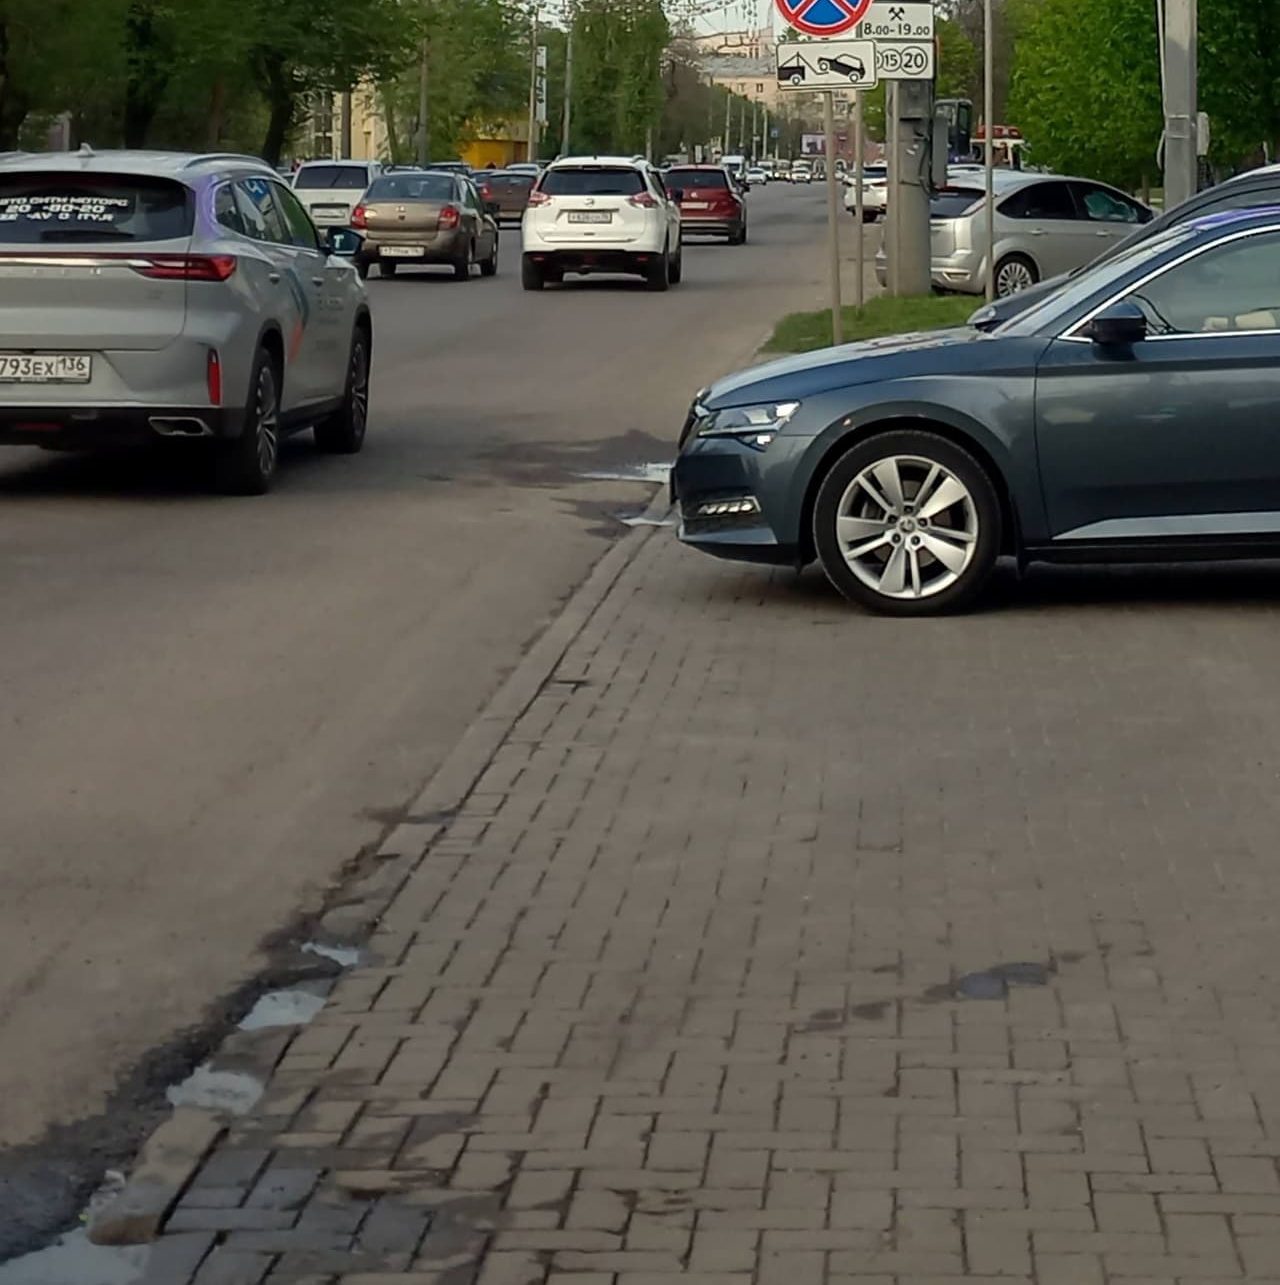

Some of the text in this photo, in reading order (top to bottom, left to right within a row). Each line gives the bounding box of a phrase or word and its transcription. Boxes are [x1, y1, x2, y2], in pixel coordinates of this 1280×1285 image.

[884, 55, 898, 66] 15
[904, 52, 925, 68] 20
[70, 197, 129, 207] МОТОРС
